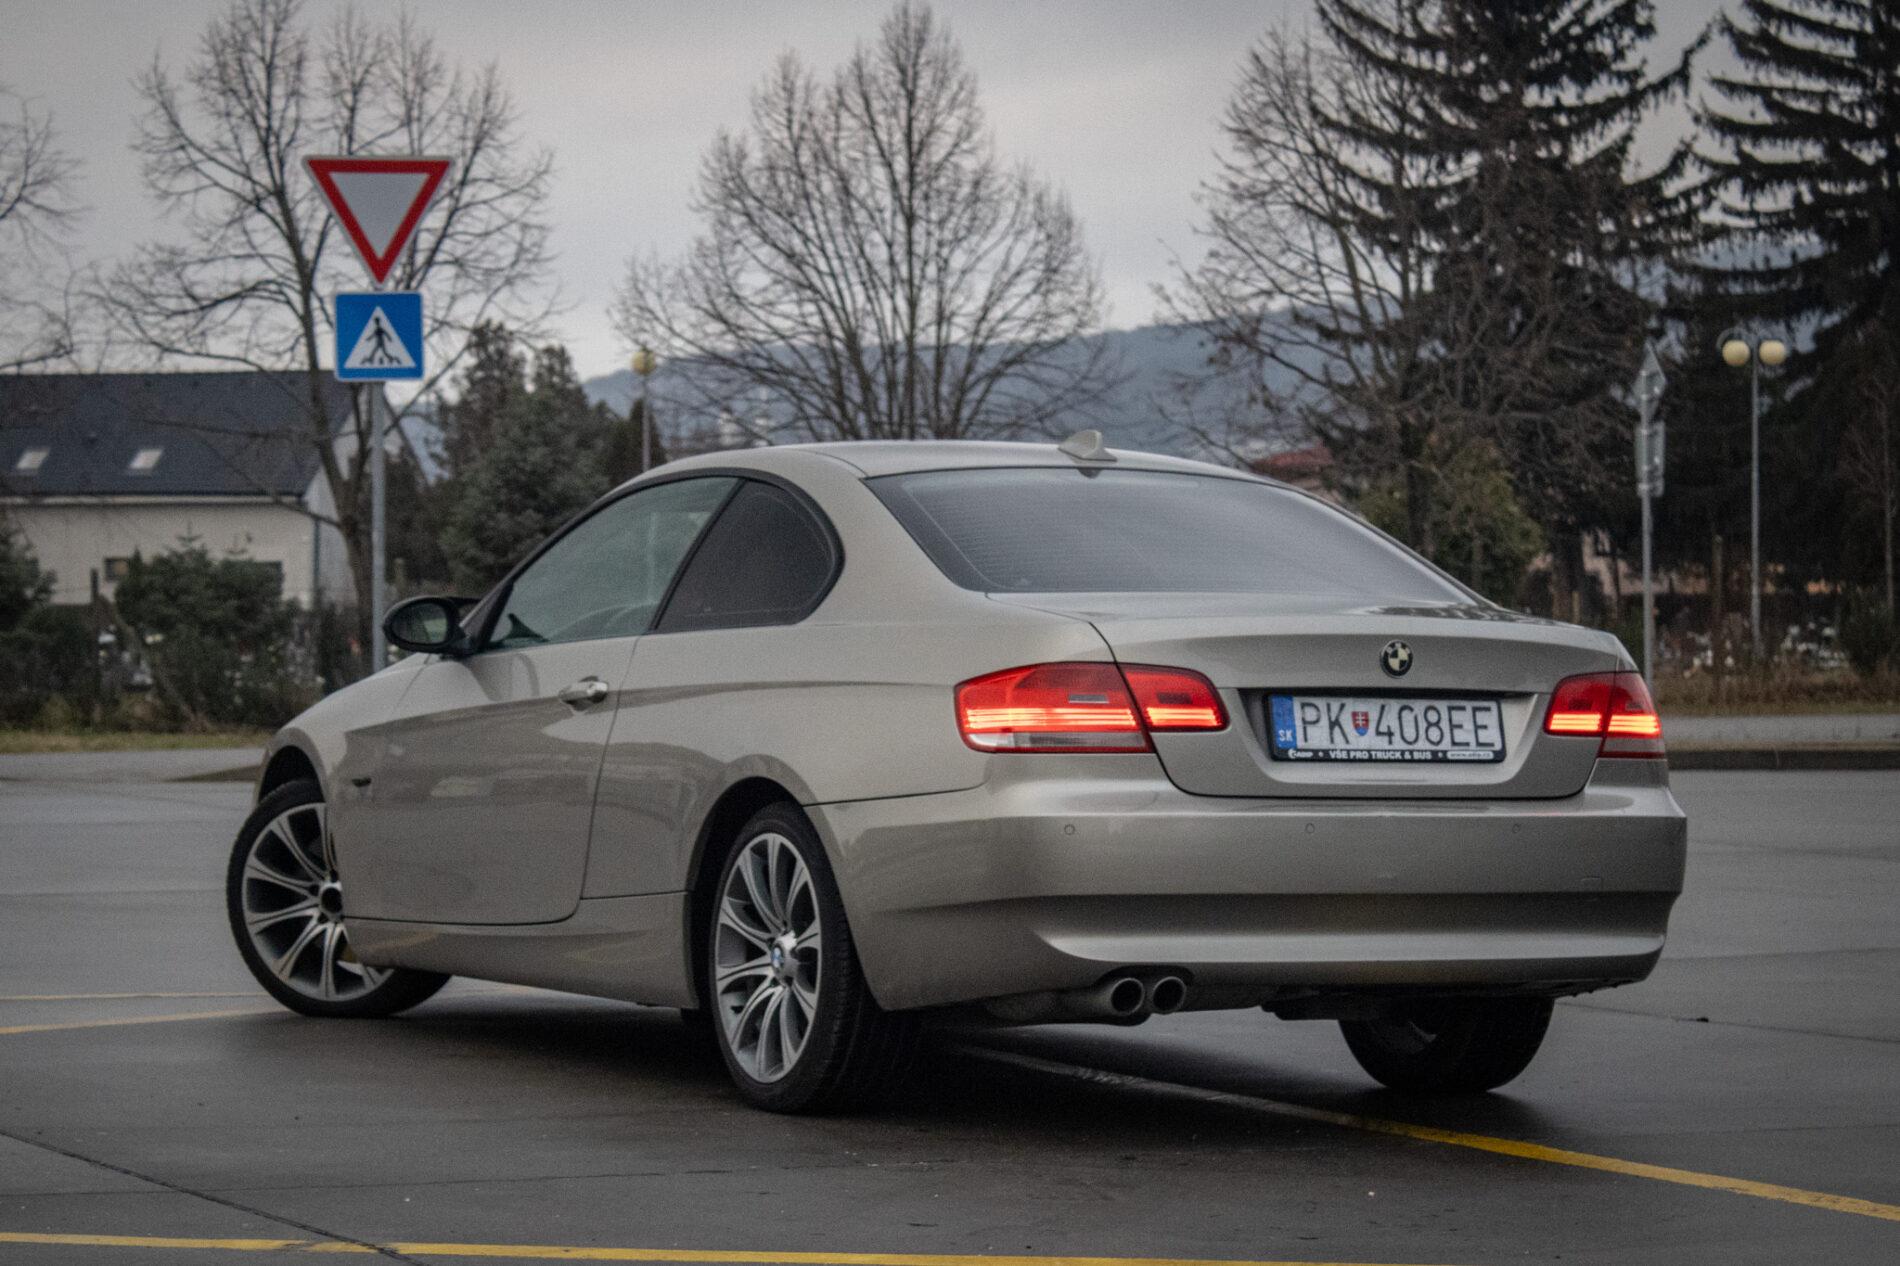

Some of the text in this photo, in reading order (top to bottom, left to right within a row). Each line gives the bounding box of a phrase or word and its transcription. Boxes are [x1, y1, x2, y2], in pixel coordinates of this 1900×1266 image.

[1300, 702, 1495, 747] PK 408EE
[1278, 729, 1293, 742] SK
[1350, 750, 1369, 759] PRO
[1370, 750, 1402, 759] TRUCK
[1404, 750, 1412, 759] &
[1413, 750, 1432, 760] BUS
